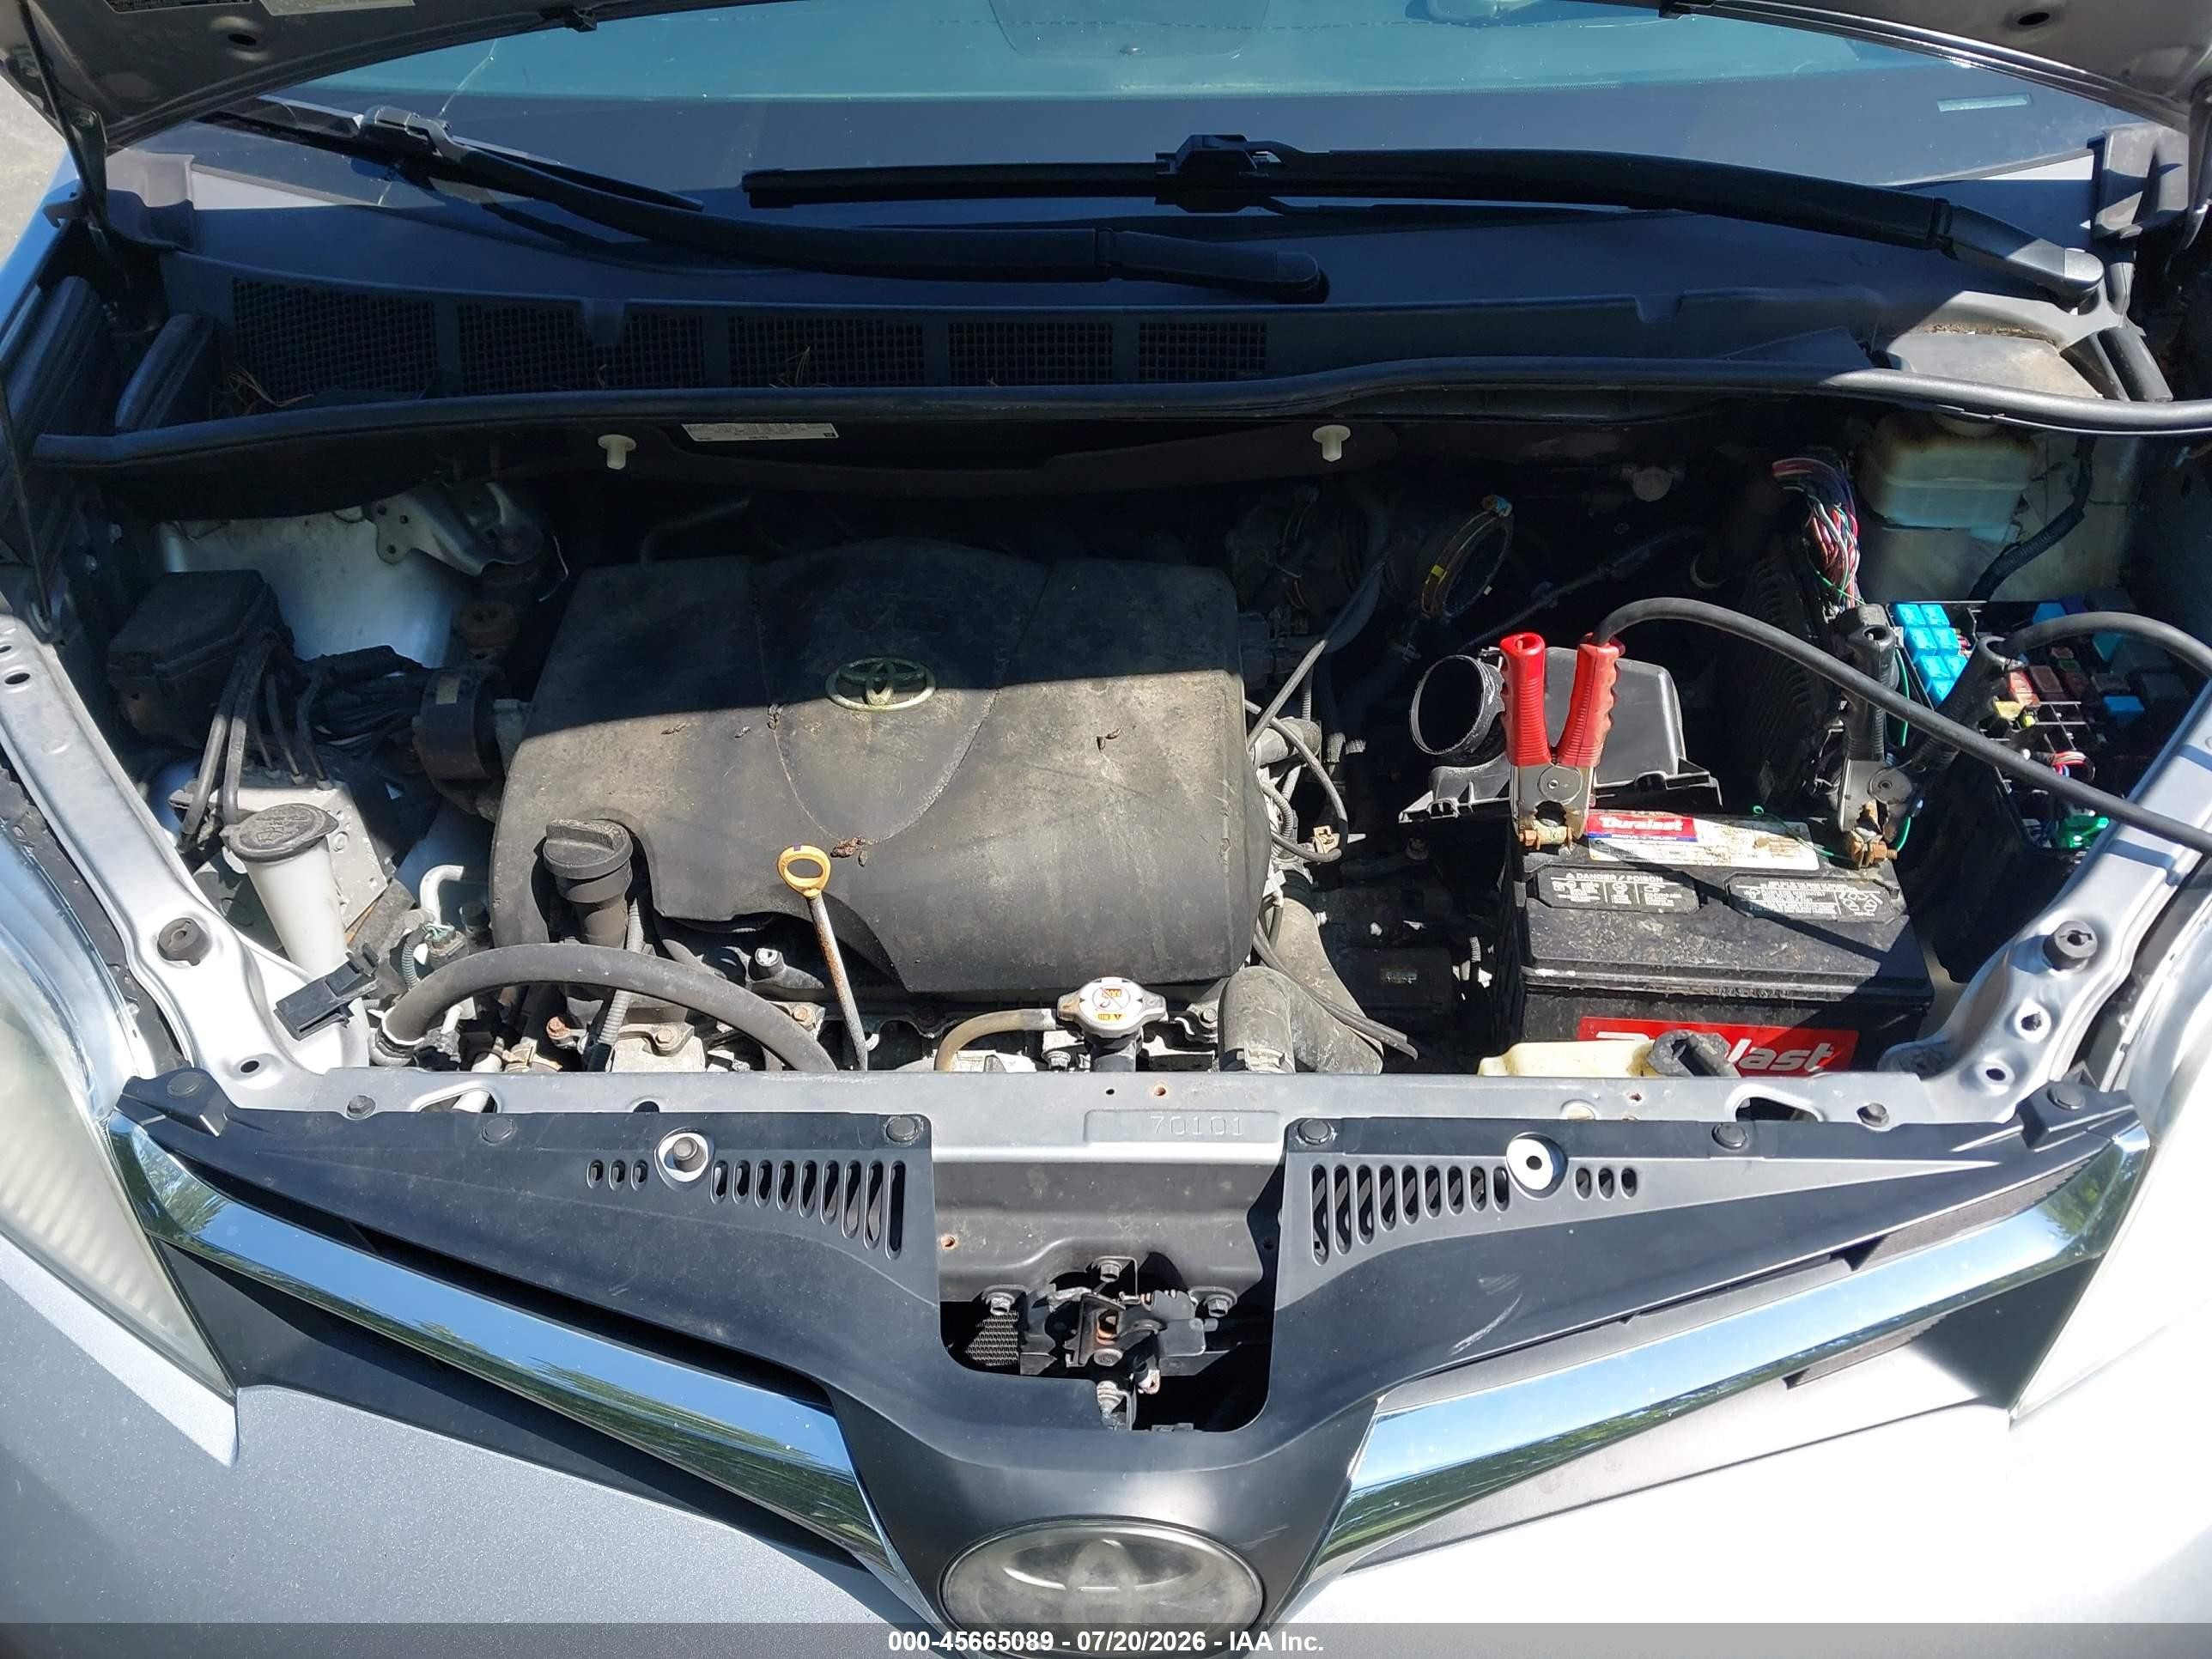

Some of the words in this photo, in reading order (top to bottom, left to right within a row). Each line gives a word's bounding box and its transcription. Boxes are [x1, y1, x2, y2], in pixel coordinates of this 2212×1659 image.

[1599, 816, 1684, 832] Duralast
[1577, 872, 1616, 881] DANGER
[1626, 874, 1664, 883] POISON
[1151, 1115, 1243, 1136] 70101
